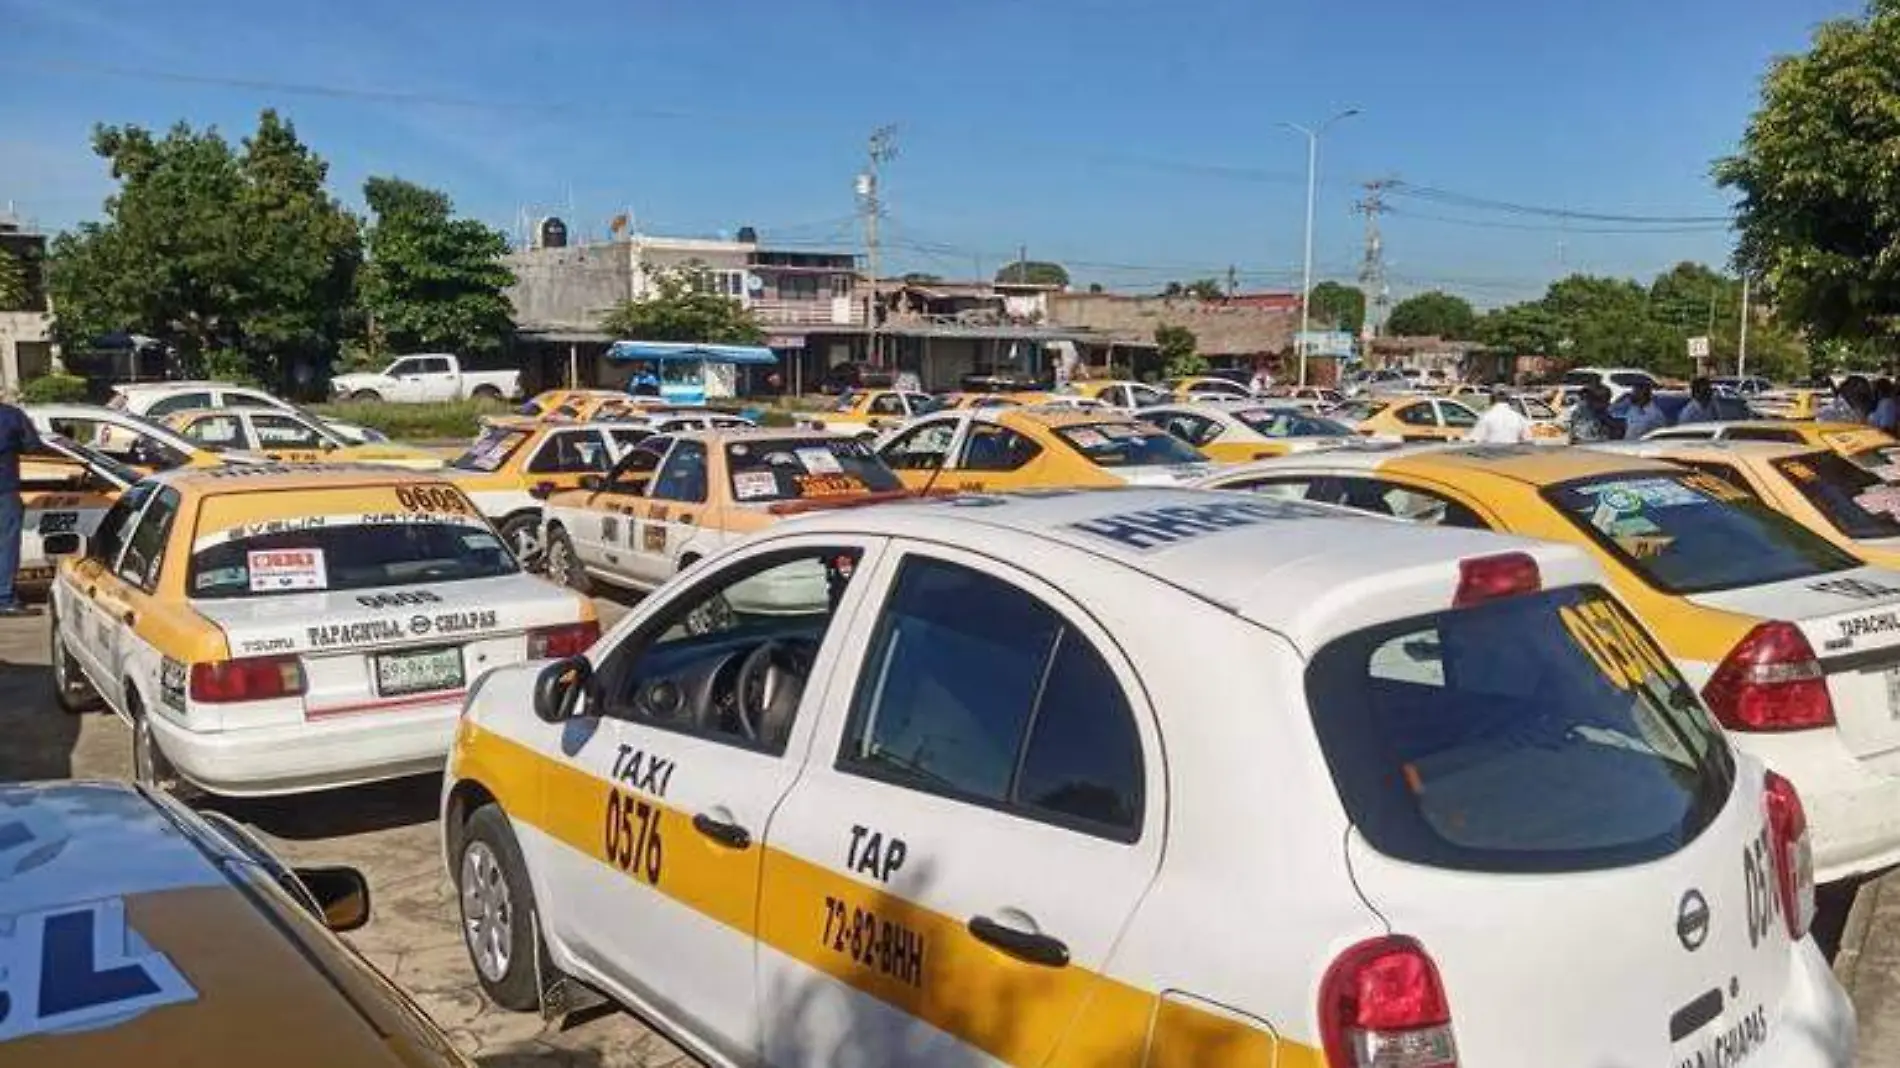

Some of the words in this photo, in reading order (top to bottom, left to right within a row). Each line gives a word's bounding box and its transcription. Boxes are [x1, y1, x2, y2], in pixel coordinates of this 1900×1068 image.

[396, 484, 467, 513] 0609
[307, 619, 404, 646] TAPACHULA
[434, 610, 497, 634] CHIAPAS
[612, 743, 676, 796] TAXI
[606, 787, 662, 885] 0576
[848, 824, 908, 883] TAP
[823, 896, 924, 988] 72-82-BHH
